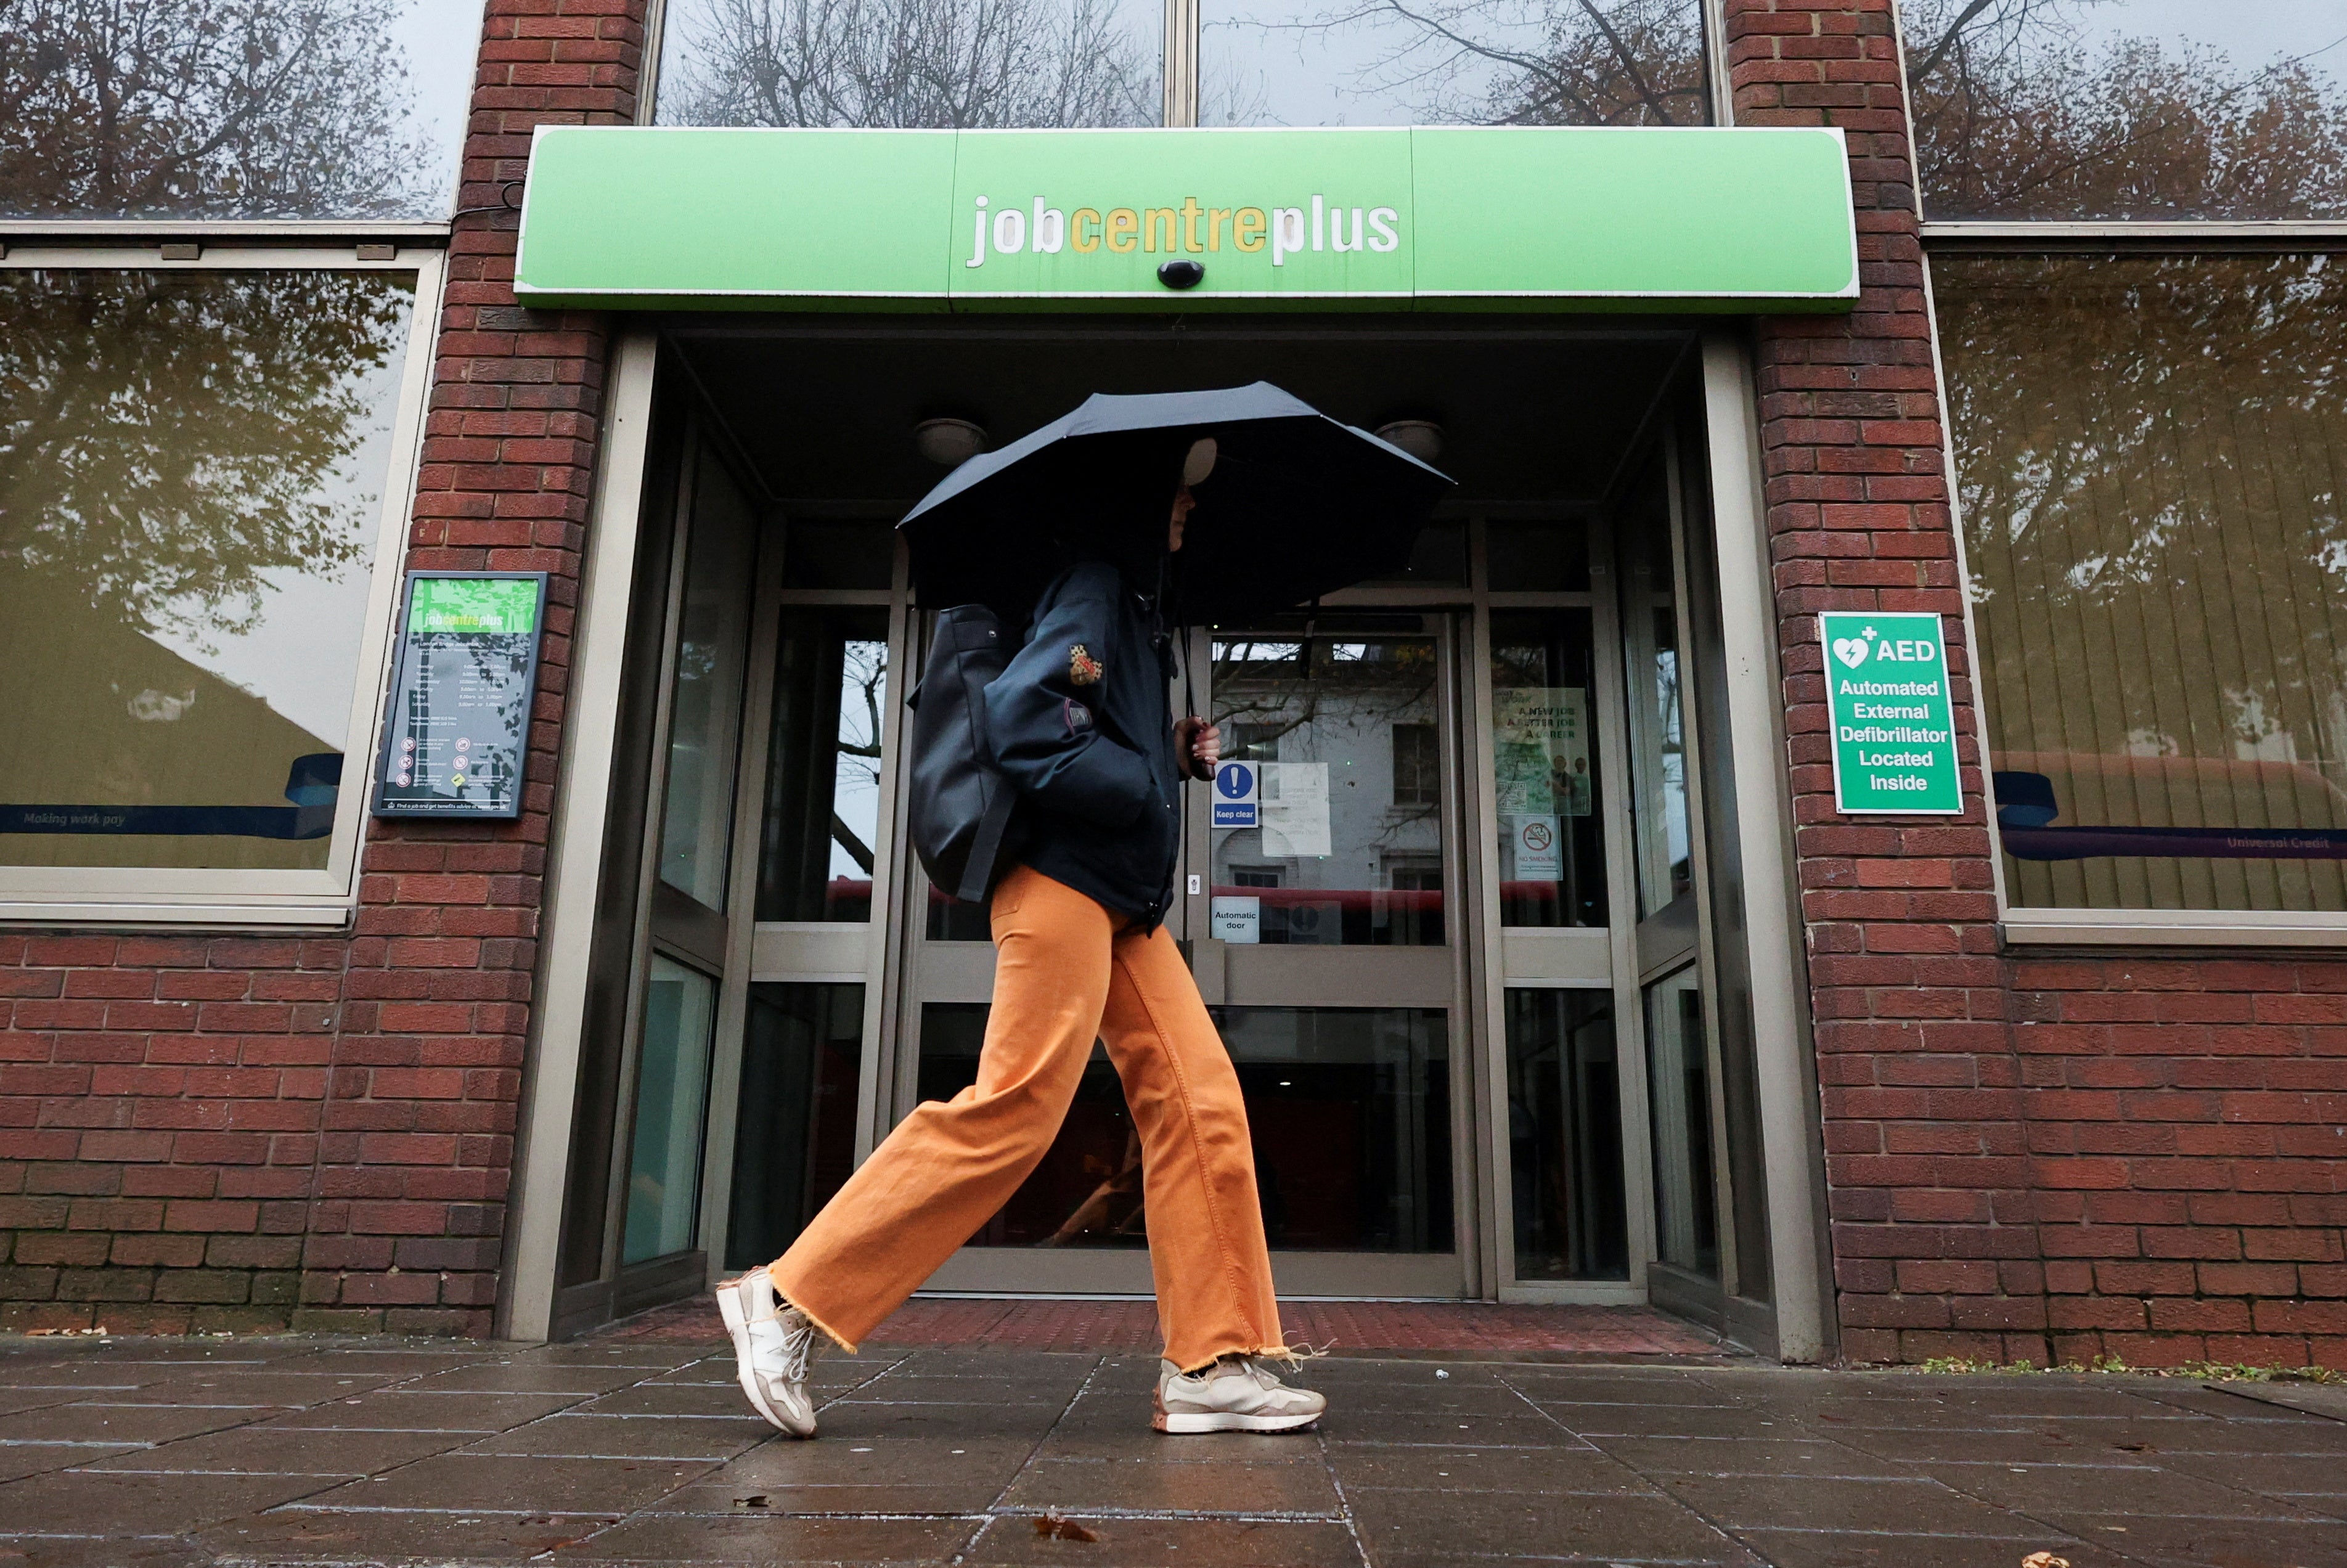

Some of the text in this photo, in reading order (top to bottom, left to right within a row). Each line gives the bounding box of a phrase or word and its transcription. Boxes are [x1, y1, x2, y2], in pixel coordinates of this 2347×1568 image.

[966, 194, 1399, 269] jobcentreplus
[423, 613, 503, 628] jobcentreplus
[1876, 640, 1935, 662] AED
[1840, 680, 1938, 696] Automated
[1529, 707, 1554, 715] NEW
[1853, 703, 1929, 719] External
[1840, 726, 1948, 743] Defibrillator
[1859, 750, 1933, 767] Located
[1870, 774, 1928, 791] Inside
[23, 813, 126, 827] Making work pay
[1216, 811, 1234, 819] Keep
[2227, 836, 2330, 849] Universal Credit
